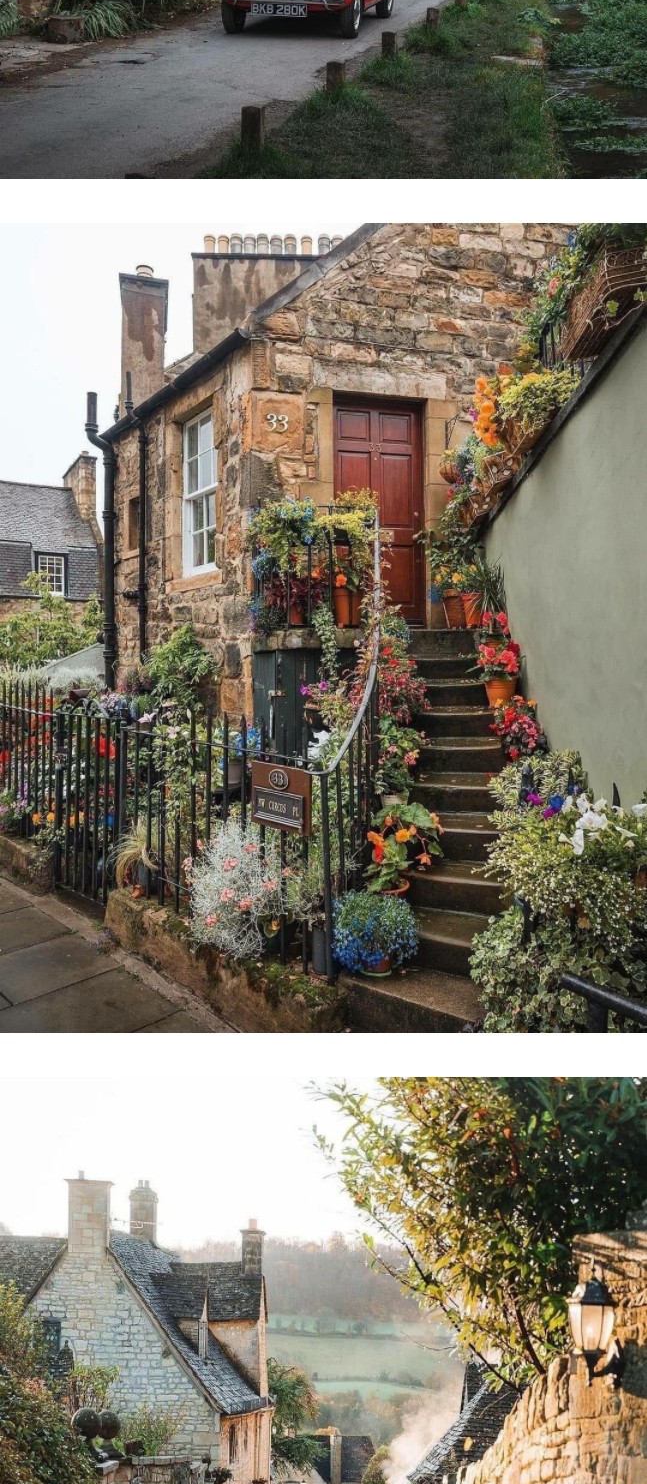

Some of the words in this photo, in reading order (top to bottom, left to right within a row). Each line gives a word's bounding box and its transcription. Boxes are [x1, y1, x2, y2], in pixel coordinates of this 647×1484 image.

[252, 3, 274, 14] BKB
[276, 4, 306, 16] 280K
[266, 413, 289, 433] 33
[369, 442, 382, 453] 33
[270, 772, 284, 786] 33
